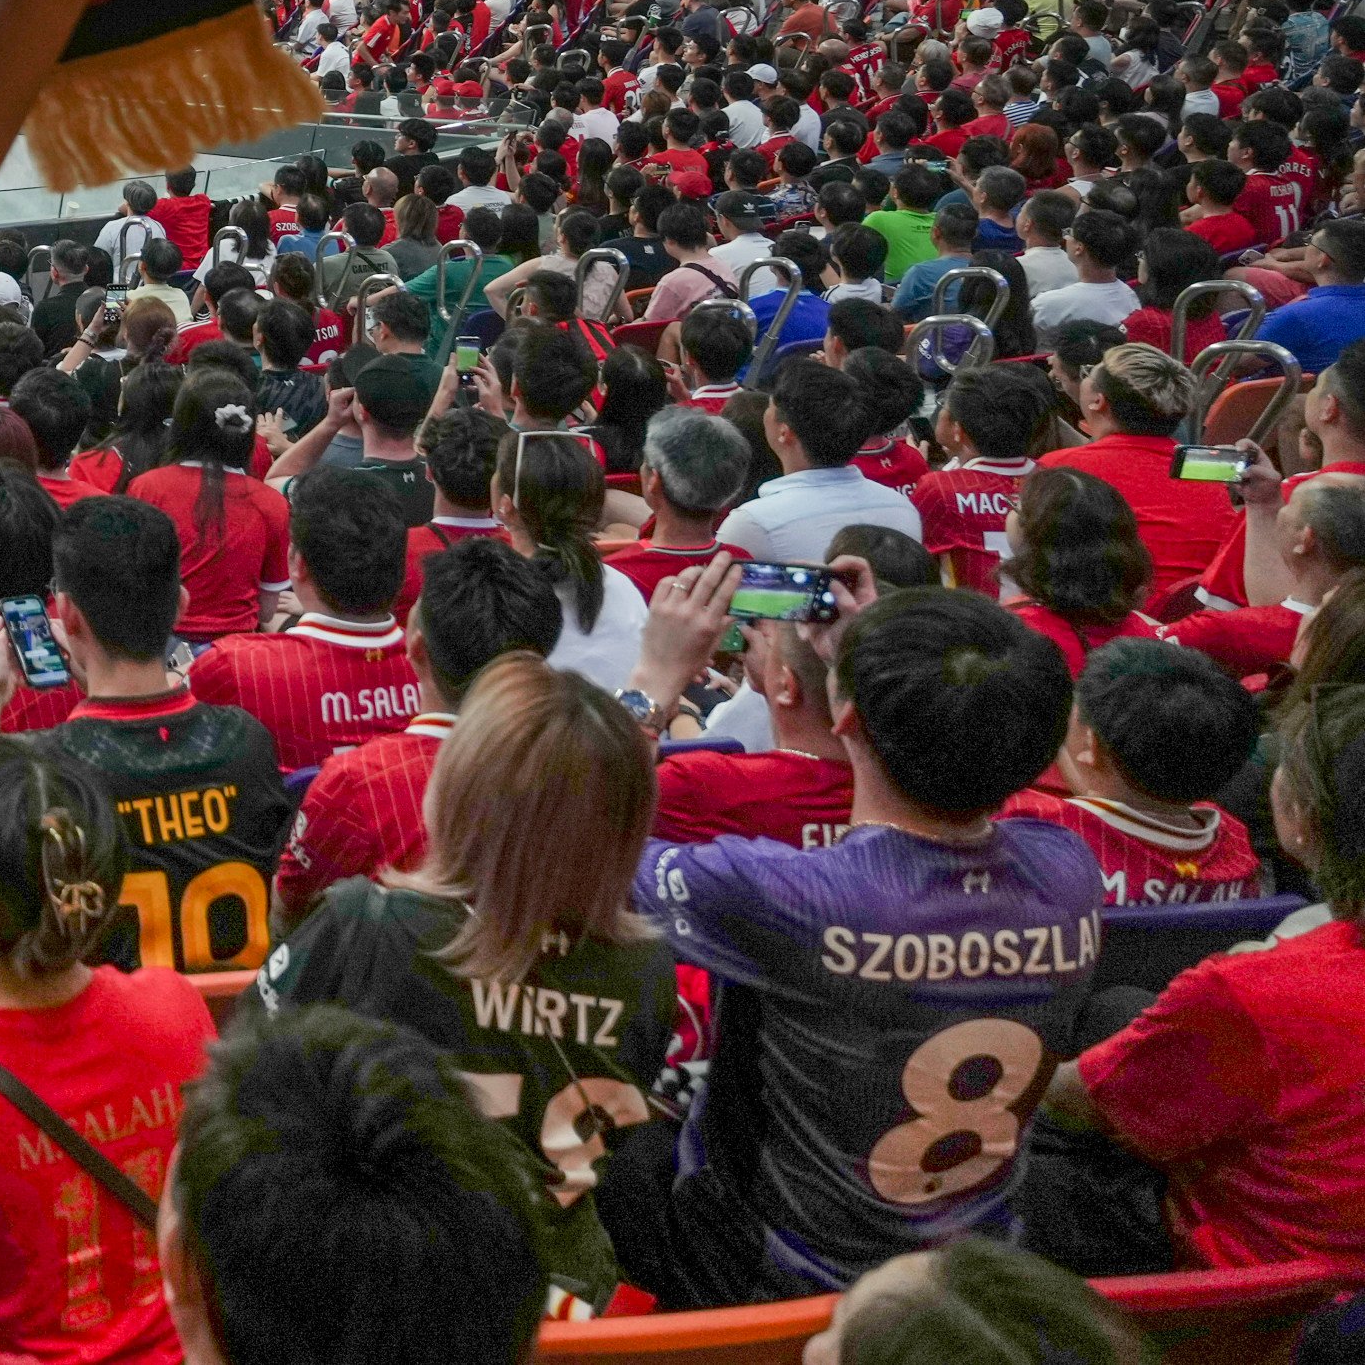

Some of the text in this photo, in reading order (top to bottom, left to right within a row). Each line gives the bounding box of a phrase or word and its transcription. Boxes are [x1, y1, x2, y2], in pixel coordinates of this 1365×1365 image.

[320, 680, 420, 725] M.SALA
[117, 785, 238, 846] "THEO"
[118, 861, 270, 972] 10
[869, 1018, 1043, 1205] 8
